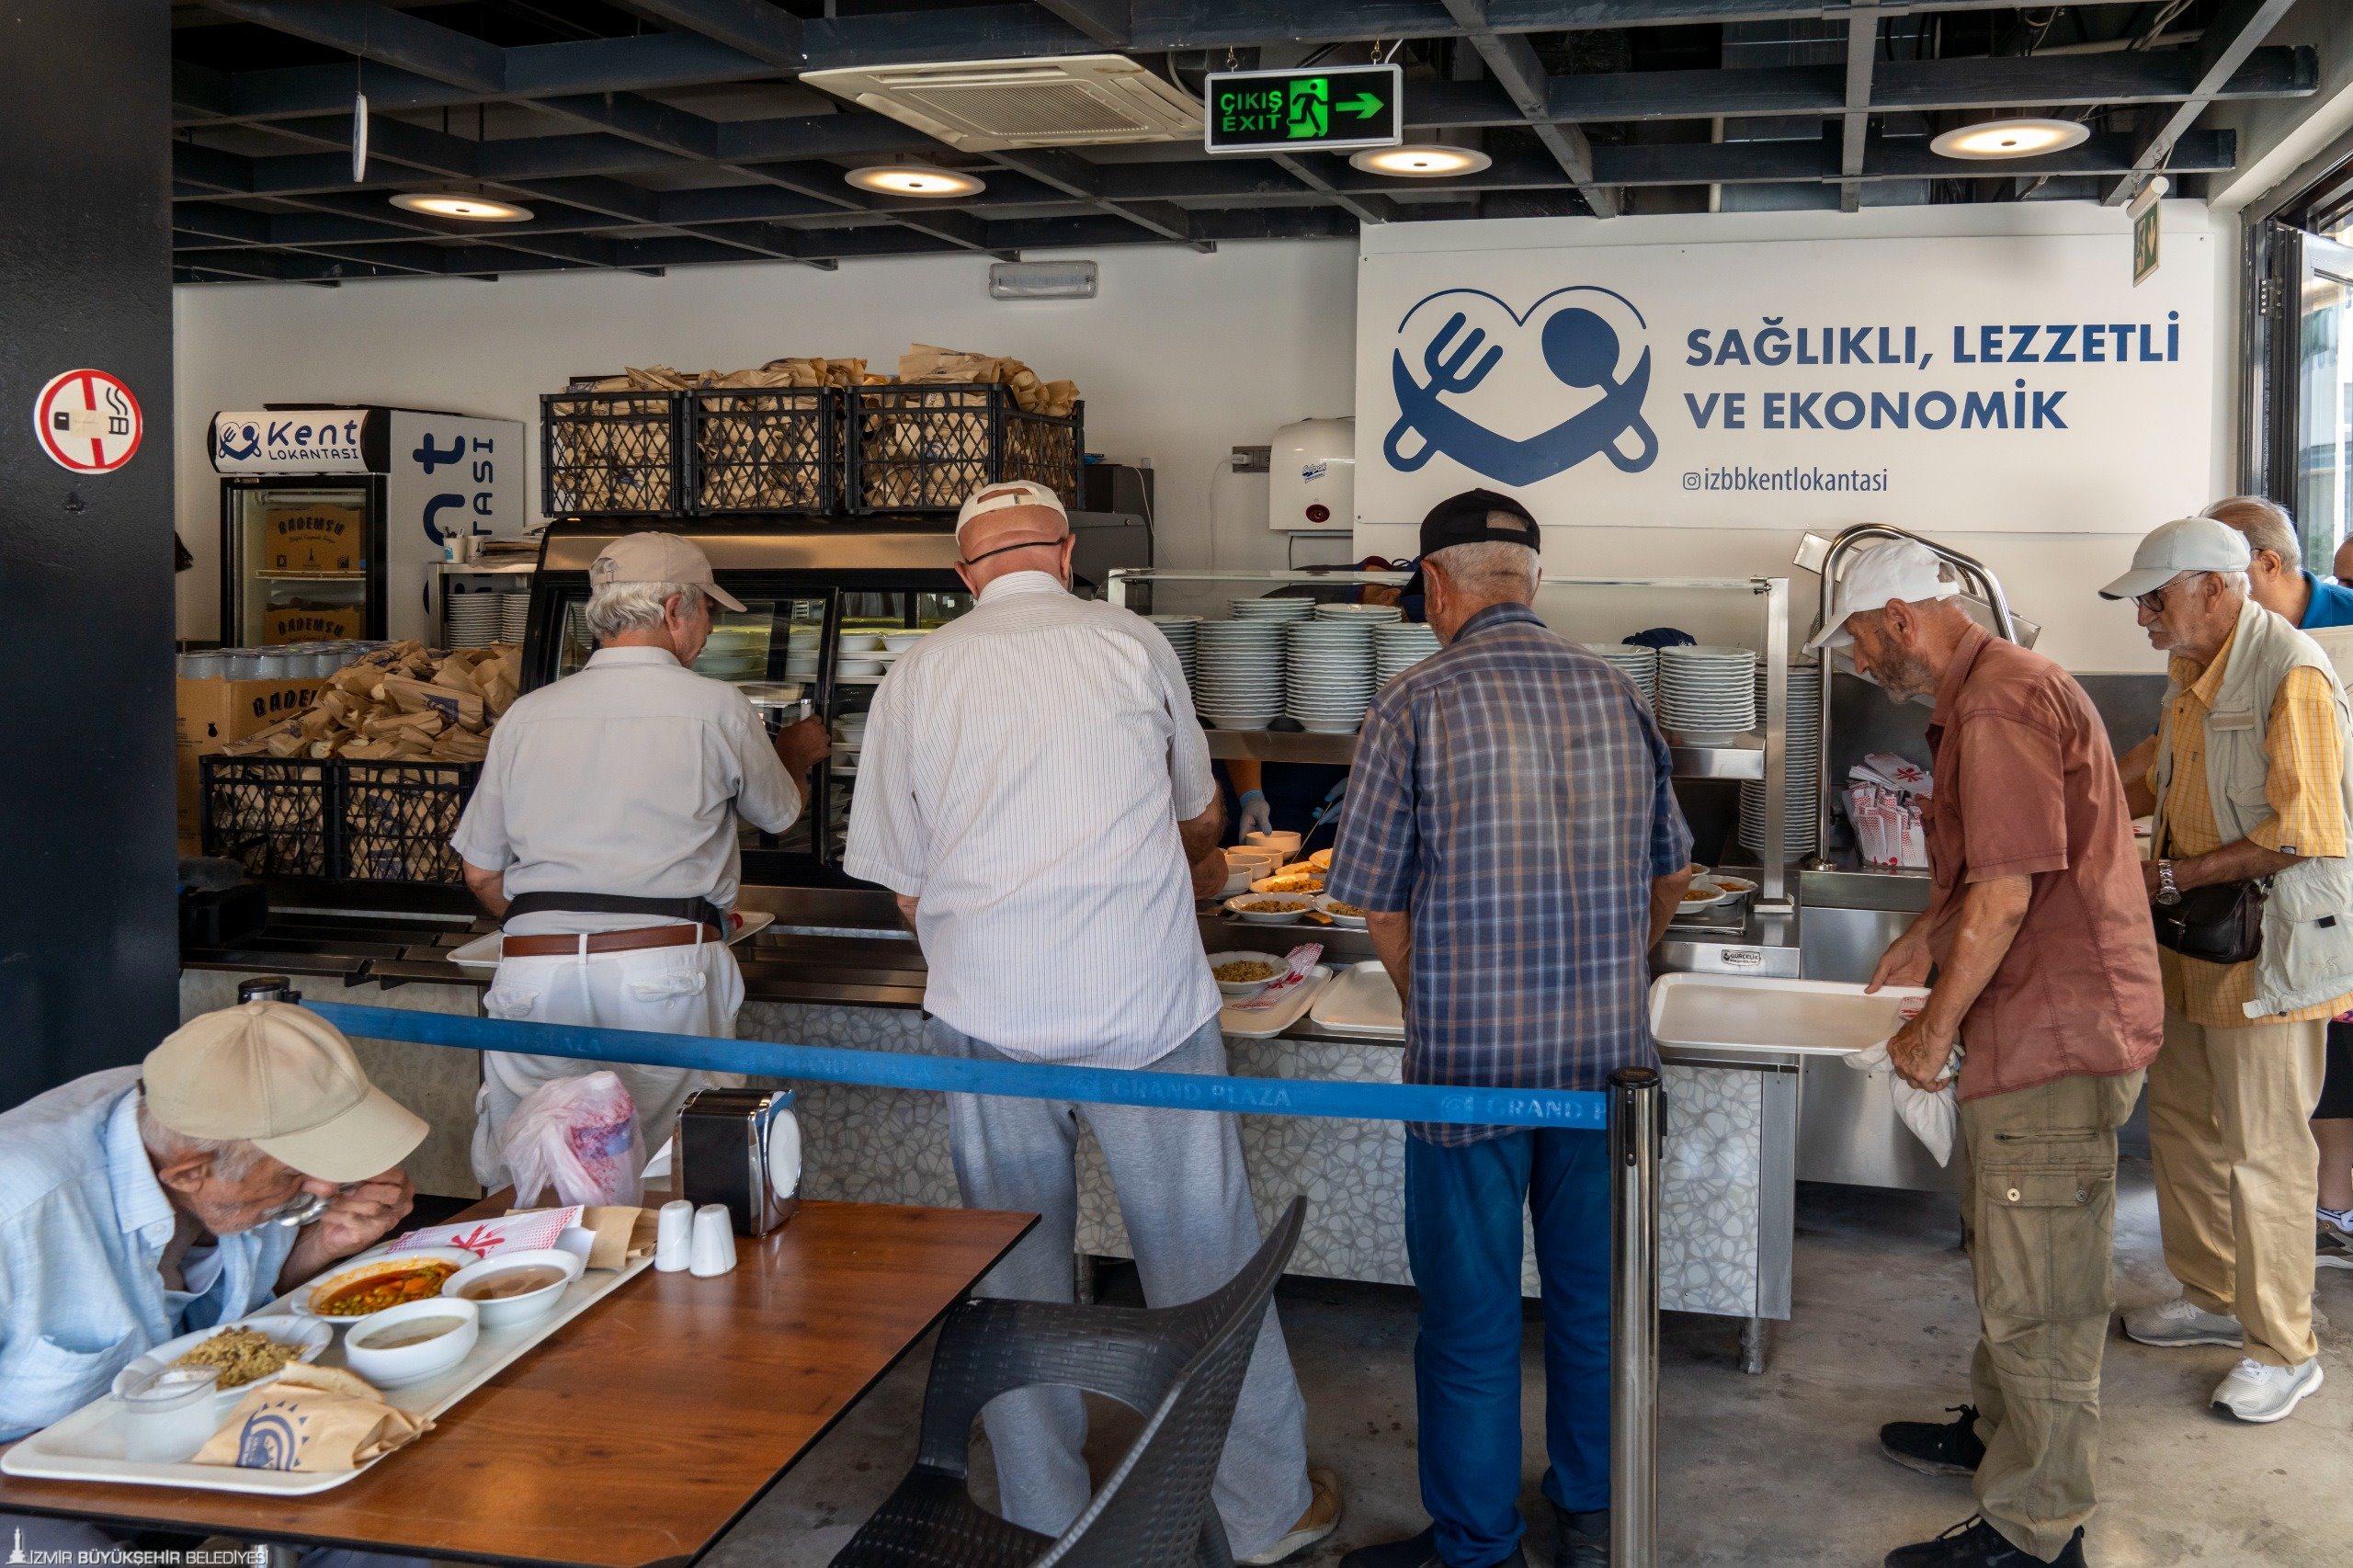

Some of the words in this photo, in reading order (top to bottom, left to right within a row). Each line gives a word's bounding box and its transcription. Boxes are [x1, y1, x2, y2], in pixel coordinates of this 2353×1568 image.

[1220, 90, 1283, 114] ÇIKIŞ
[1222, 113, 1281, 132] EXIT
[1686, 316, 1933, 370] SAĞLIKLI,
[1953, 310, 2179, 363] LEZZETLİ
[1683, 392, 1745, 429] VE
[1763, 378, 2068, 430] EKONOMİK
[267, 419, 358, 447] Kent
[268, 449, 358, 460] LOKANTASI
[1705, 467, 1888, 493] izbbkentlokantasi
[1211, 1084, 1291, 1107] PLAZA
[1487, 1097, 1583, 1119] GRAND
